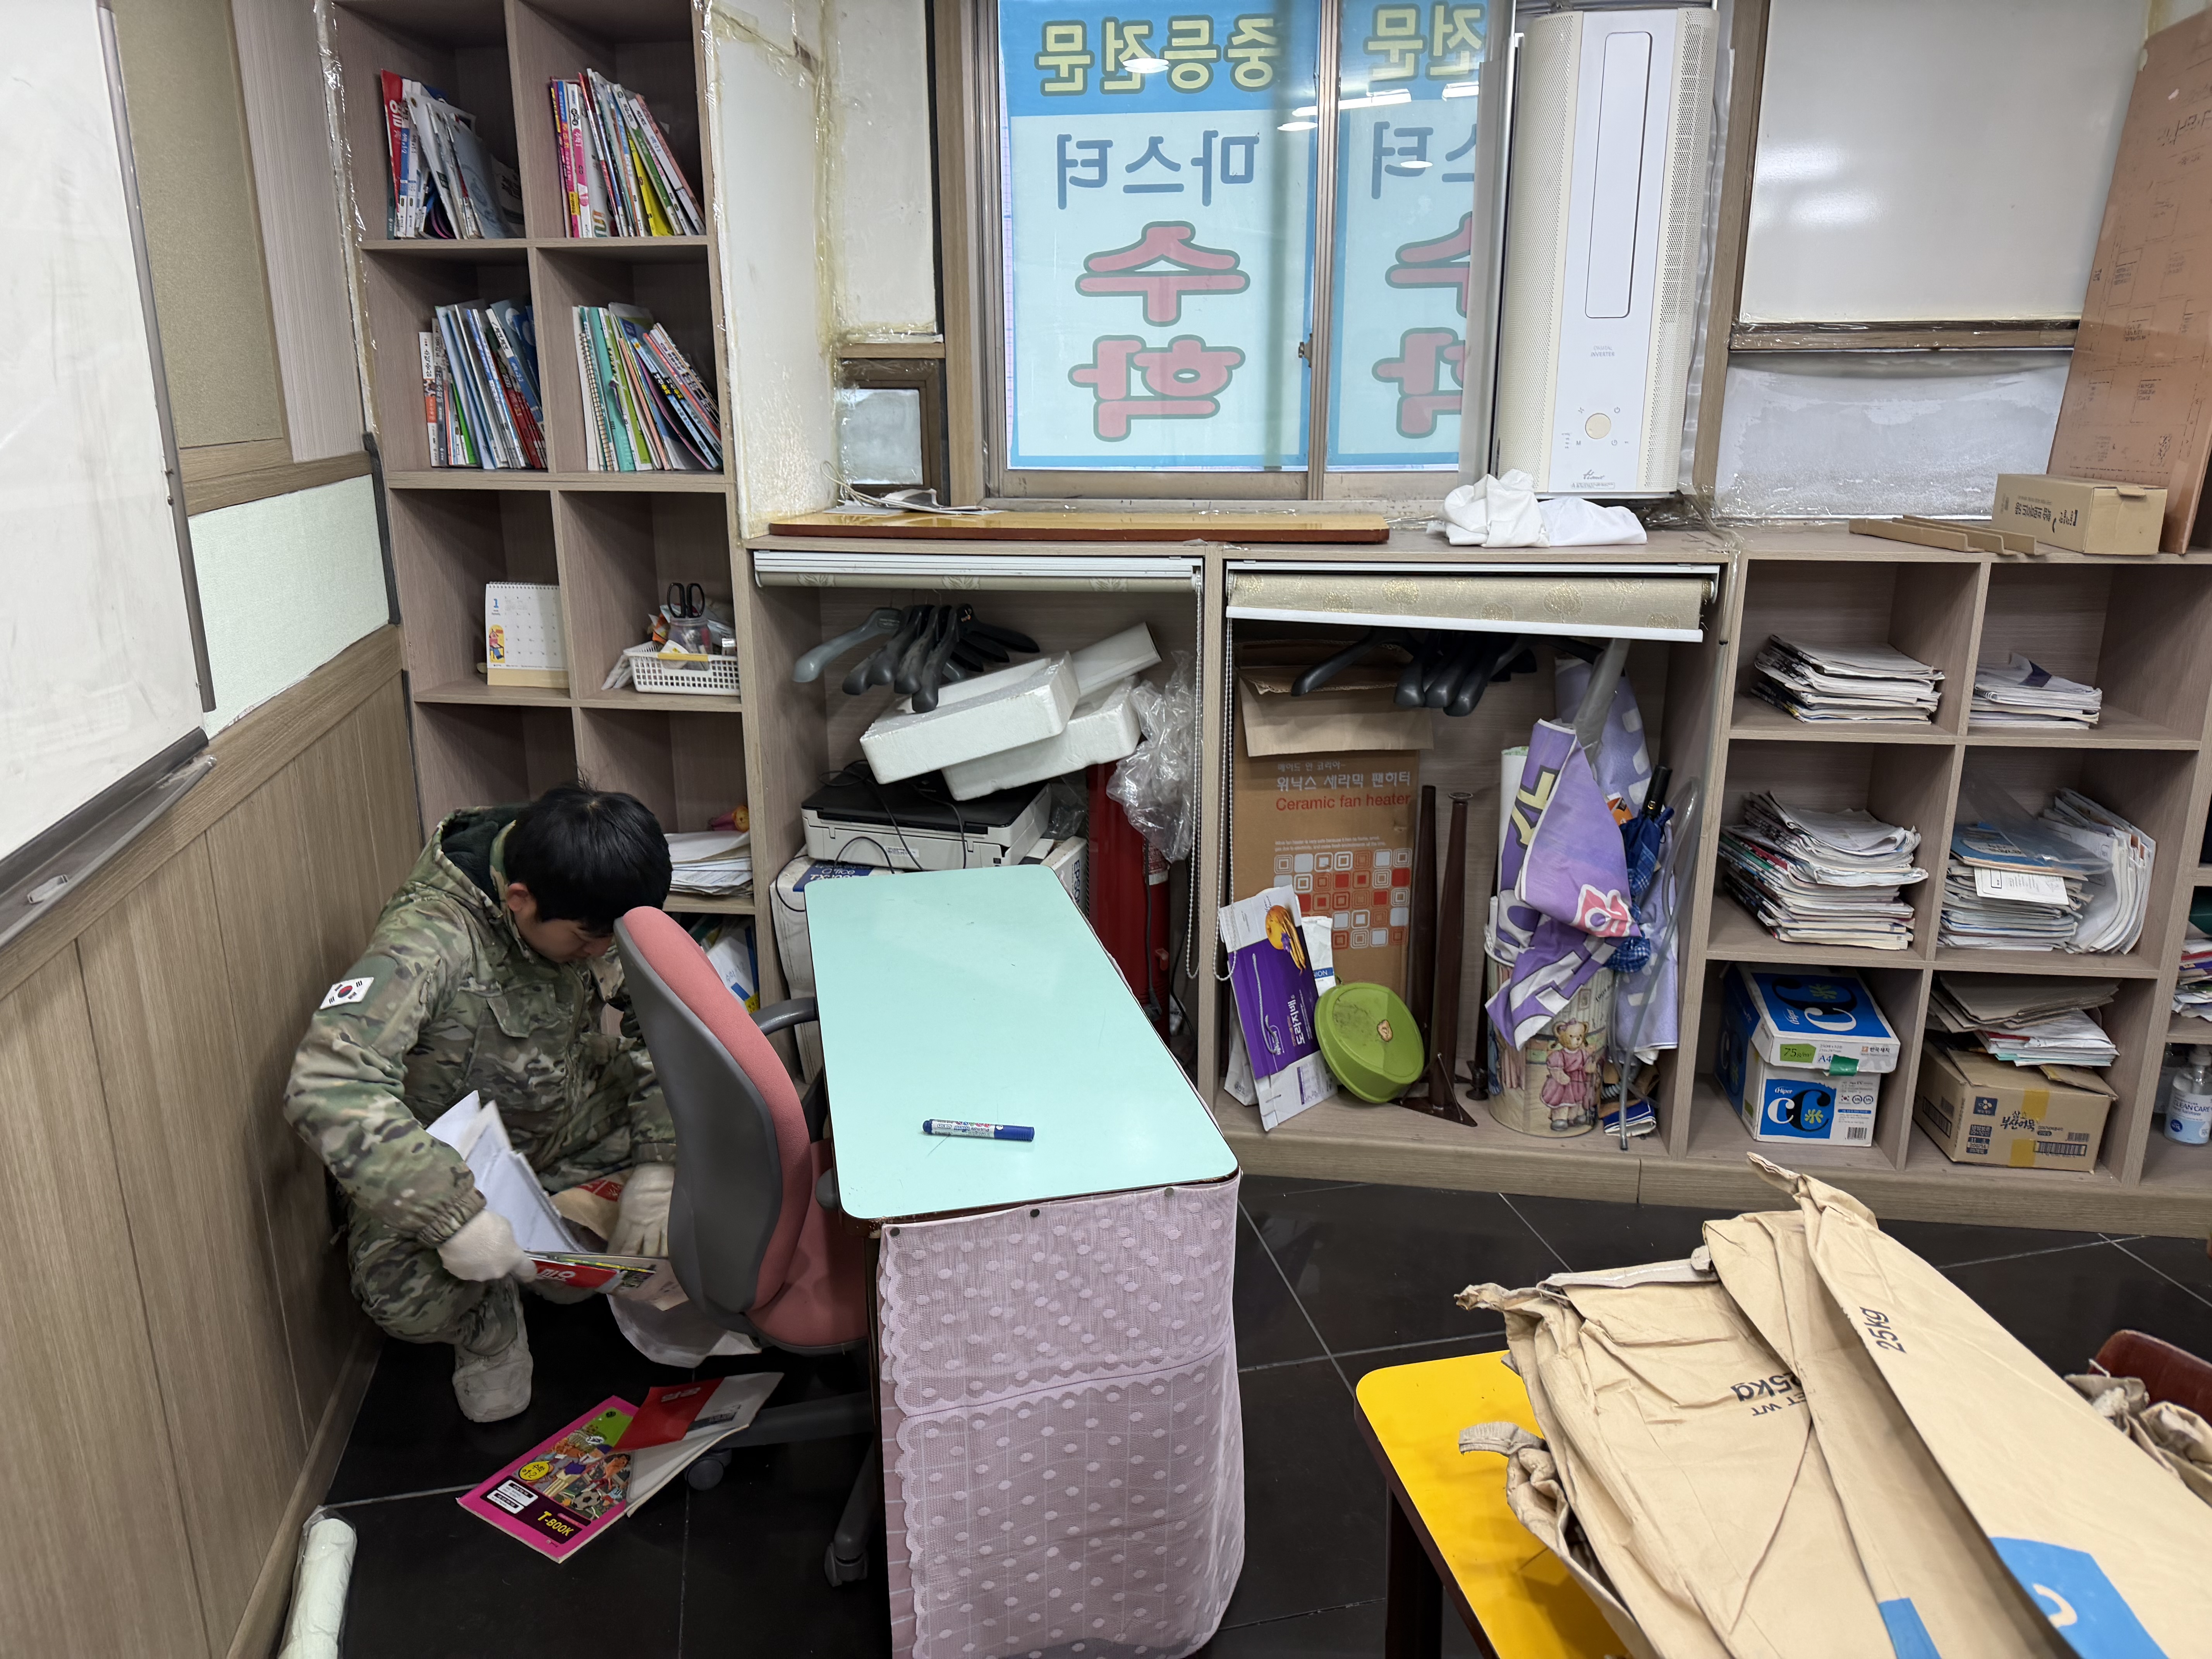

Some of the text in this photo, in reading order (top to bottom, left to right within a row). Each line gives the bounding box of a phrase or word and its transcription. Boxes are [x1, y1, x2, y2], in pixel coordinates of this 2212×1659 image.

[494, 598, 499, 608] 1
[1277, 771, 1410, 792] 위닉스 세라믹 팬히터
[1276, 793, 1411, 811] Ceramic fan heater
[1818, 1054, 1832, 1063] A4
[2173, 1100, 2193, 1110] CLEAN
[2000, 1116, 2035, 1132] 부산어묵
[1859, 1306, 1906, 1353] 25kg
[1750, 1403, 1783, 1416] WT
[538, 1511, 574, 1537] T-BOOK
